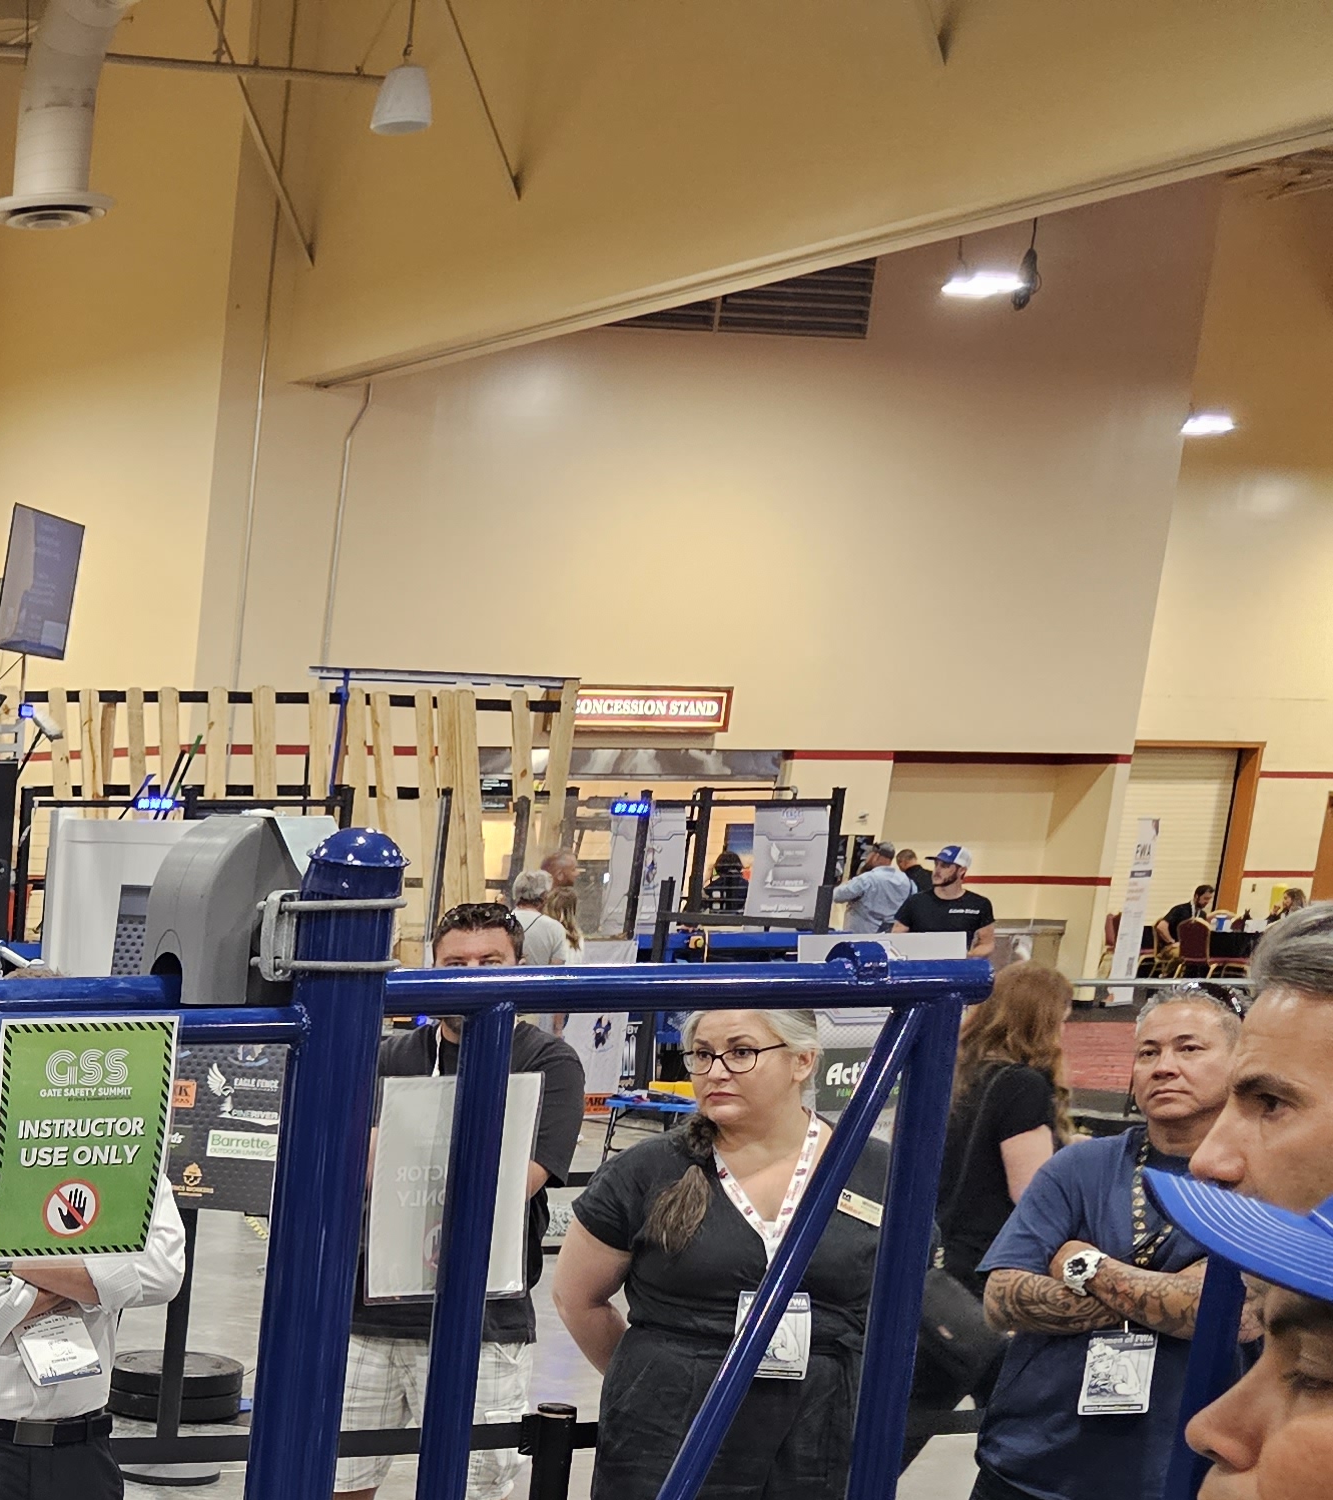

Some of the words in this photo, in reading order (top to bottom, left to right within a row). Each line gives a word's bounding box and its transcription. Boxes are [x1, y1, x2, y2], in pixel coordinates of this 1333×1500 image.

[668, 701, 719, 716] STAND
[45, 1048, 131, 1086] GSS
[40, 1088, 64, 1098] GATE
[64, 1087, 97, 1097] SAFETY
[97, 1086, 133, 1097] SUMMIT
[17, 1116, 146, 1141] INSTRUCTOR
[210, 1133, 270, 1149] Barrette
[19, 1146, 69, 1168] USE
[72, 1144, 141, 1166] ONLY
